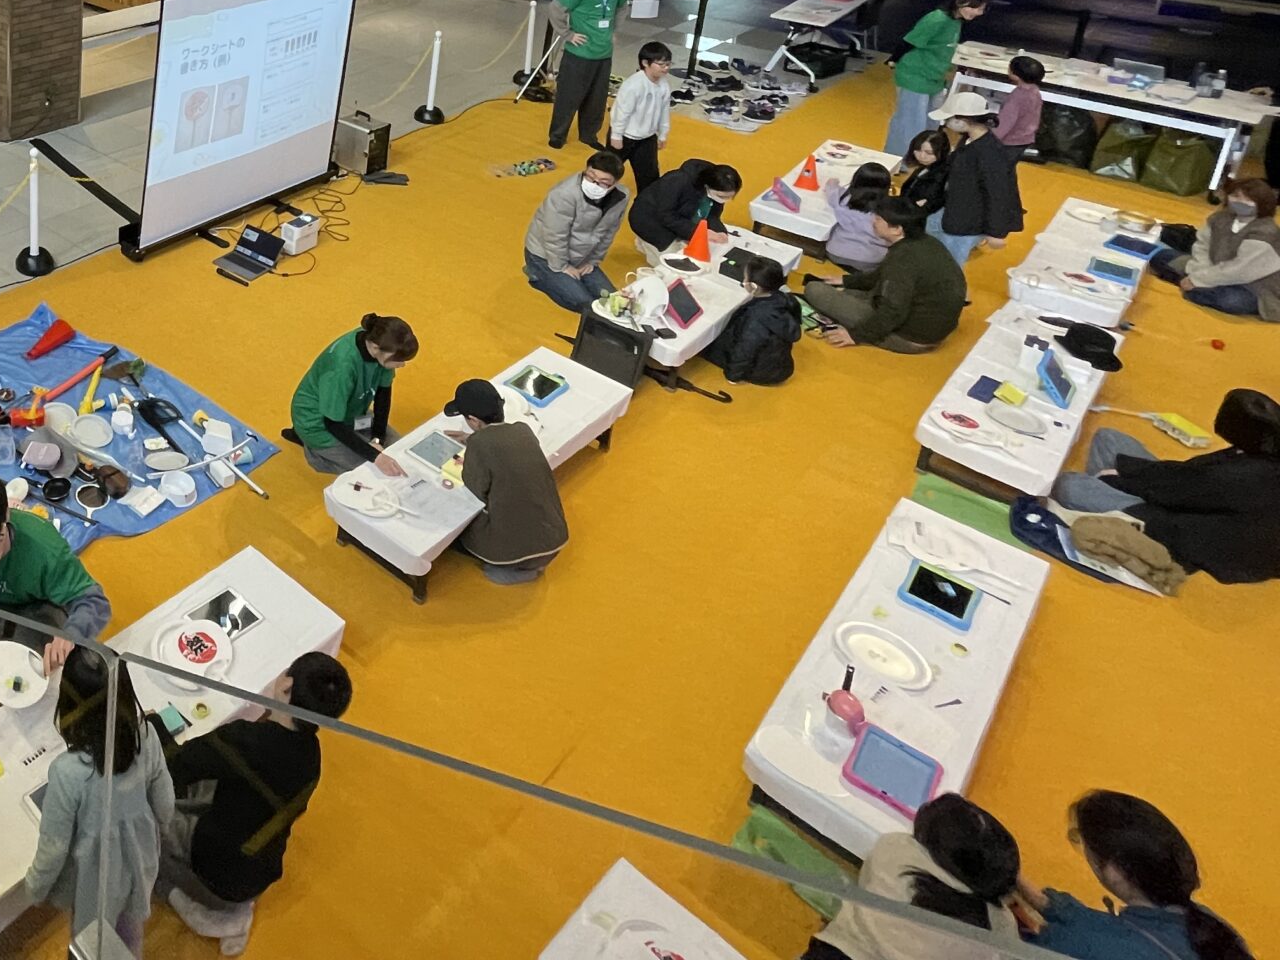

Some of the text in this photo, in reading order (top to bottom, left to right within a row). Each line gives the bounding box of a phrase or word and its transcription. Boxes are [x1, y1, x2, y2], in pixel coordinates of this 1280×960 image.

[181, 37, 246, 61] ワークシートの
